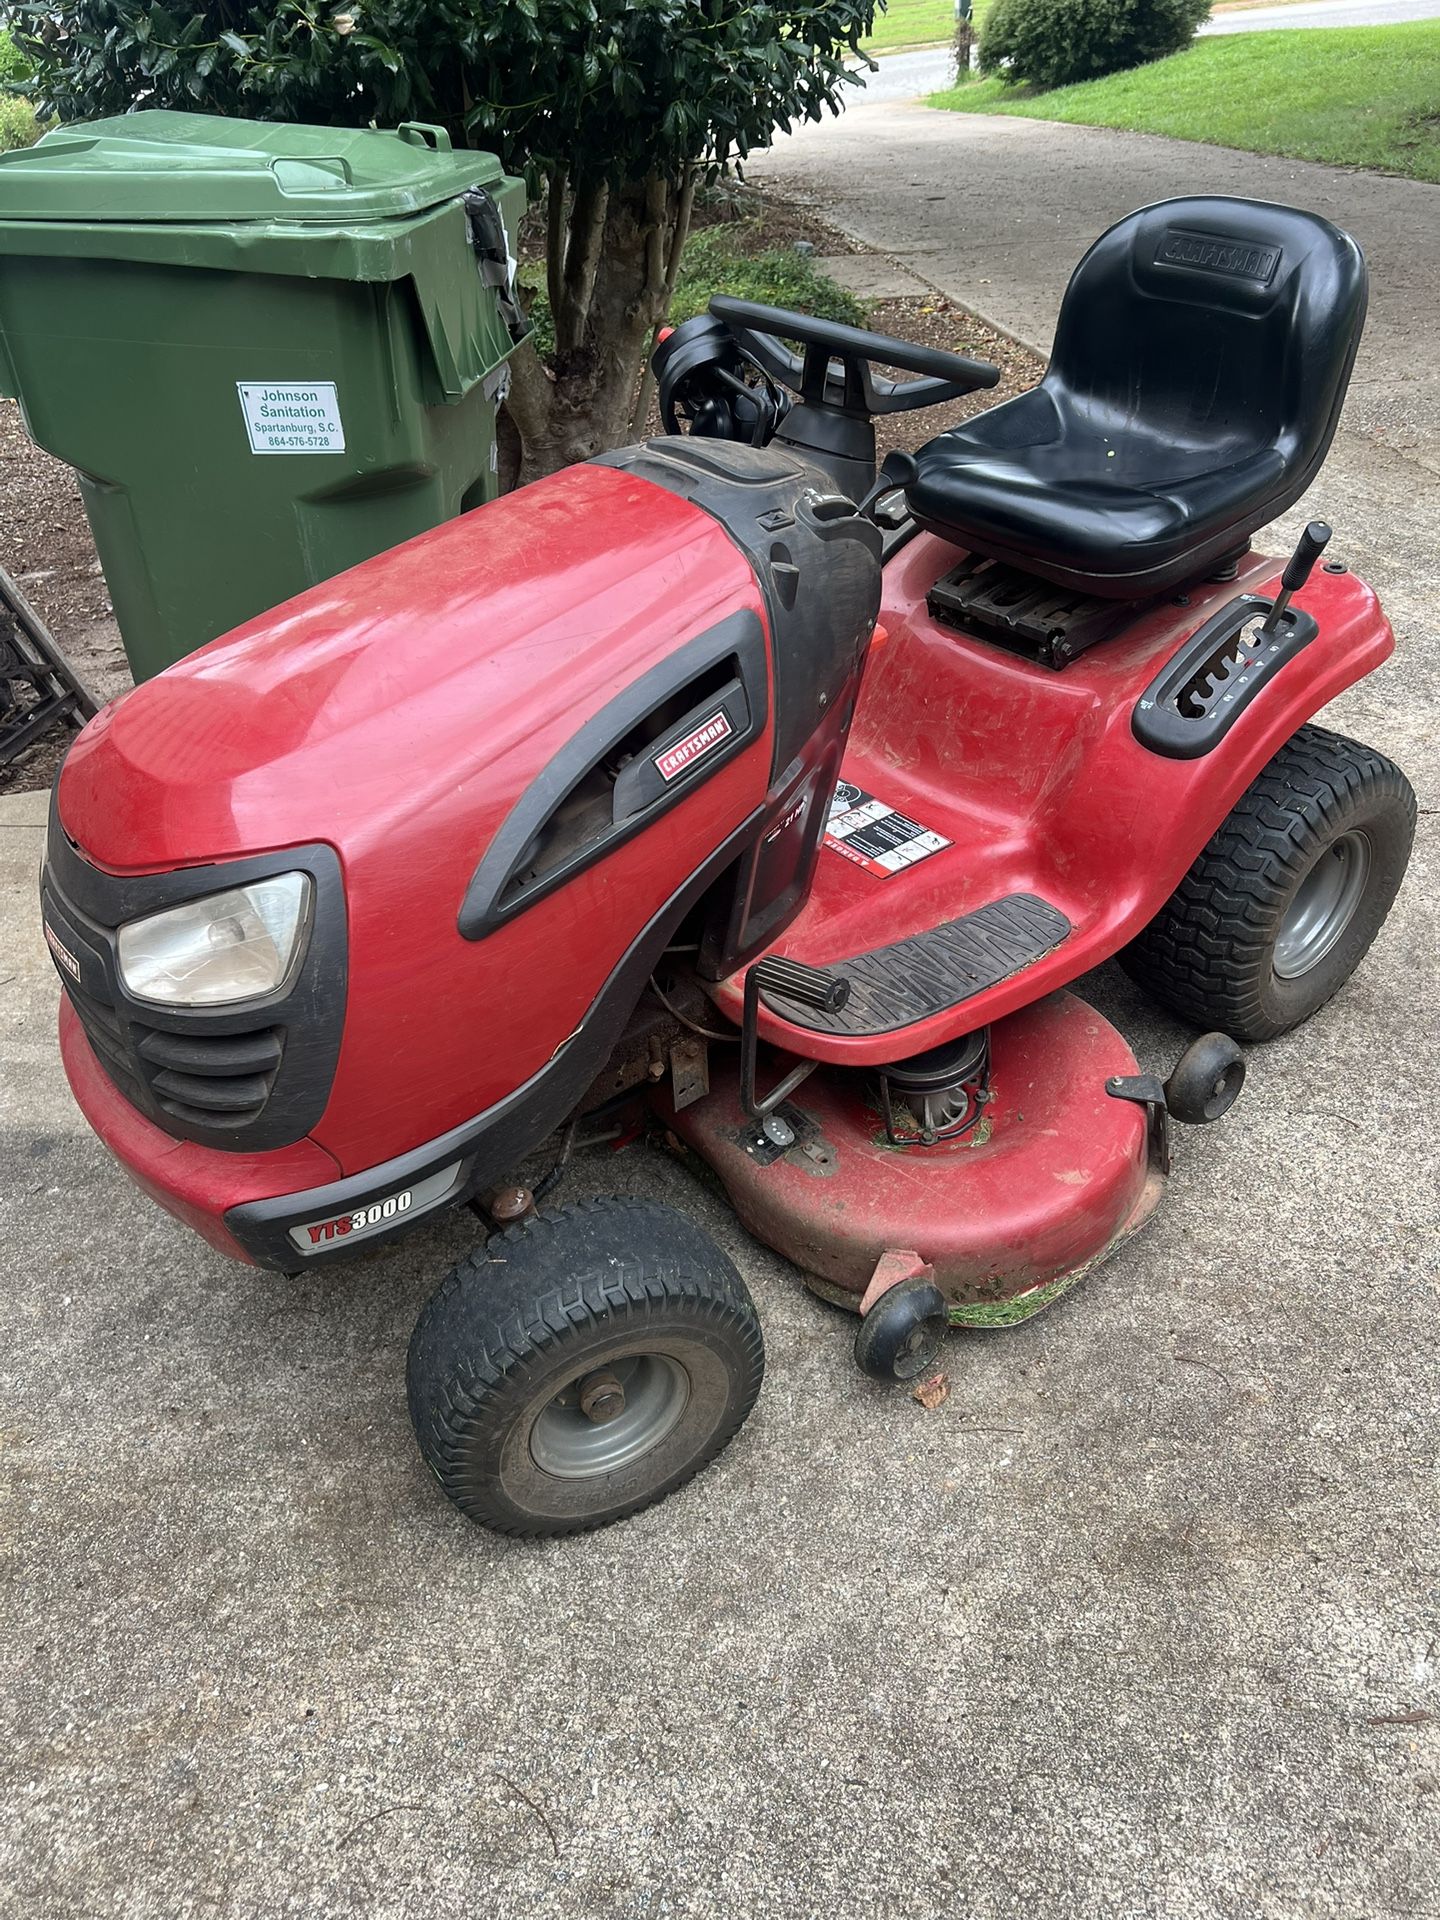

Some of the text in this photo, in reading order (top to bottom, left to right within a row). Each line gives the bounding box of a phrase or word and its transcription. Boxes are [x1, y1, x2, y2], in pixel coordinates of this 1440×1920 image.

[1163, 238, 1273, 278] CRAFTSMAN
[261, 389, 318, 402] Johnson
[260, 404, 326, 418] Sanitation
[254, 422, 339, 435] Spartanburg, S.C.
[268, 436, 330, 447] 864-576-5728
[662, 720, 725, 772] CRAFTSMAN
[307, 1191, 413, 1244] YTS3000
